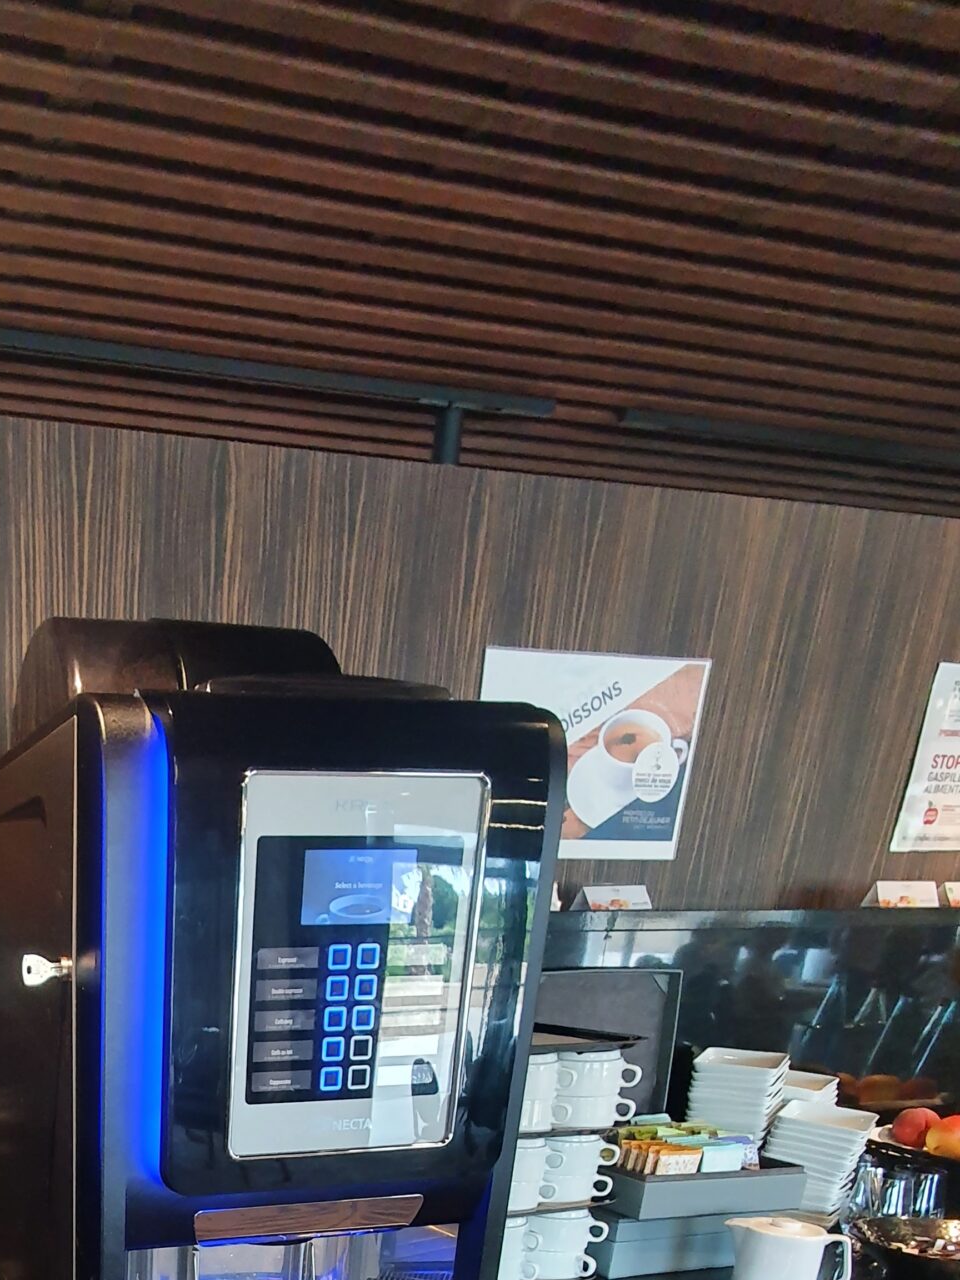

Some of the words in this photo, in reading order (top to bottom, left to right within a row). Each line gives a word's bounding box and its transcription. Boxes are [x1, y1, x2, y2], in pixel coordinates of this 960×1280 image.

[560, 681, 623, 733] OISSONS
[927, 771, 960, 782] GASPIL
[333, 1118, 372, 1131] NECTA
